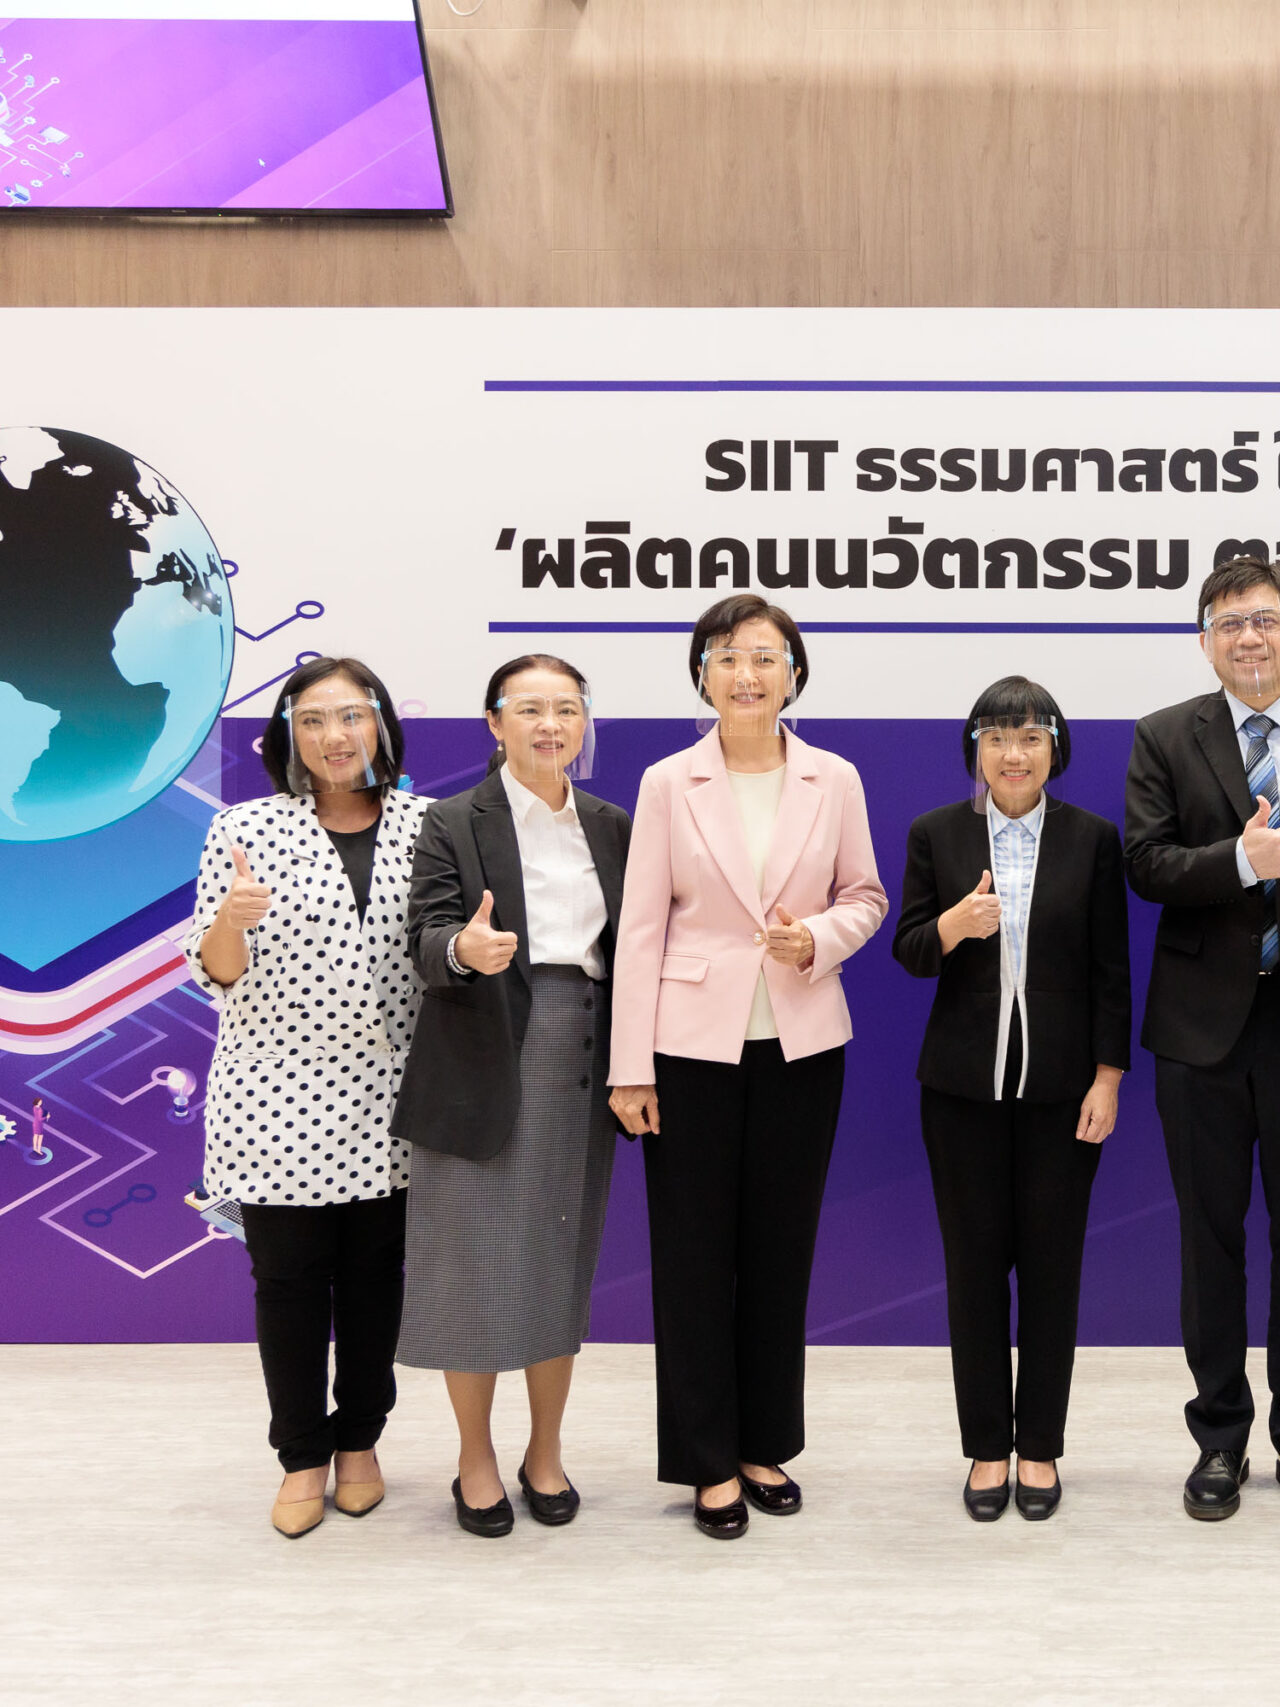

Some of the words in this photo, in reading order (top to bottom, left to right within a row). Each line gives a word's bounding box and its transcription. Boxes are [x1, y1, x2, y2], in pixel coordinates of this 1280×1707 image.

[704, 439, 839, 492] SIIT
[856, 431, 1260, 493] ธรรมศาสตร์
